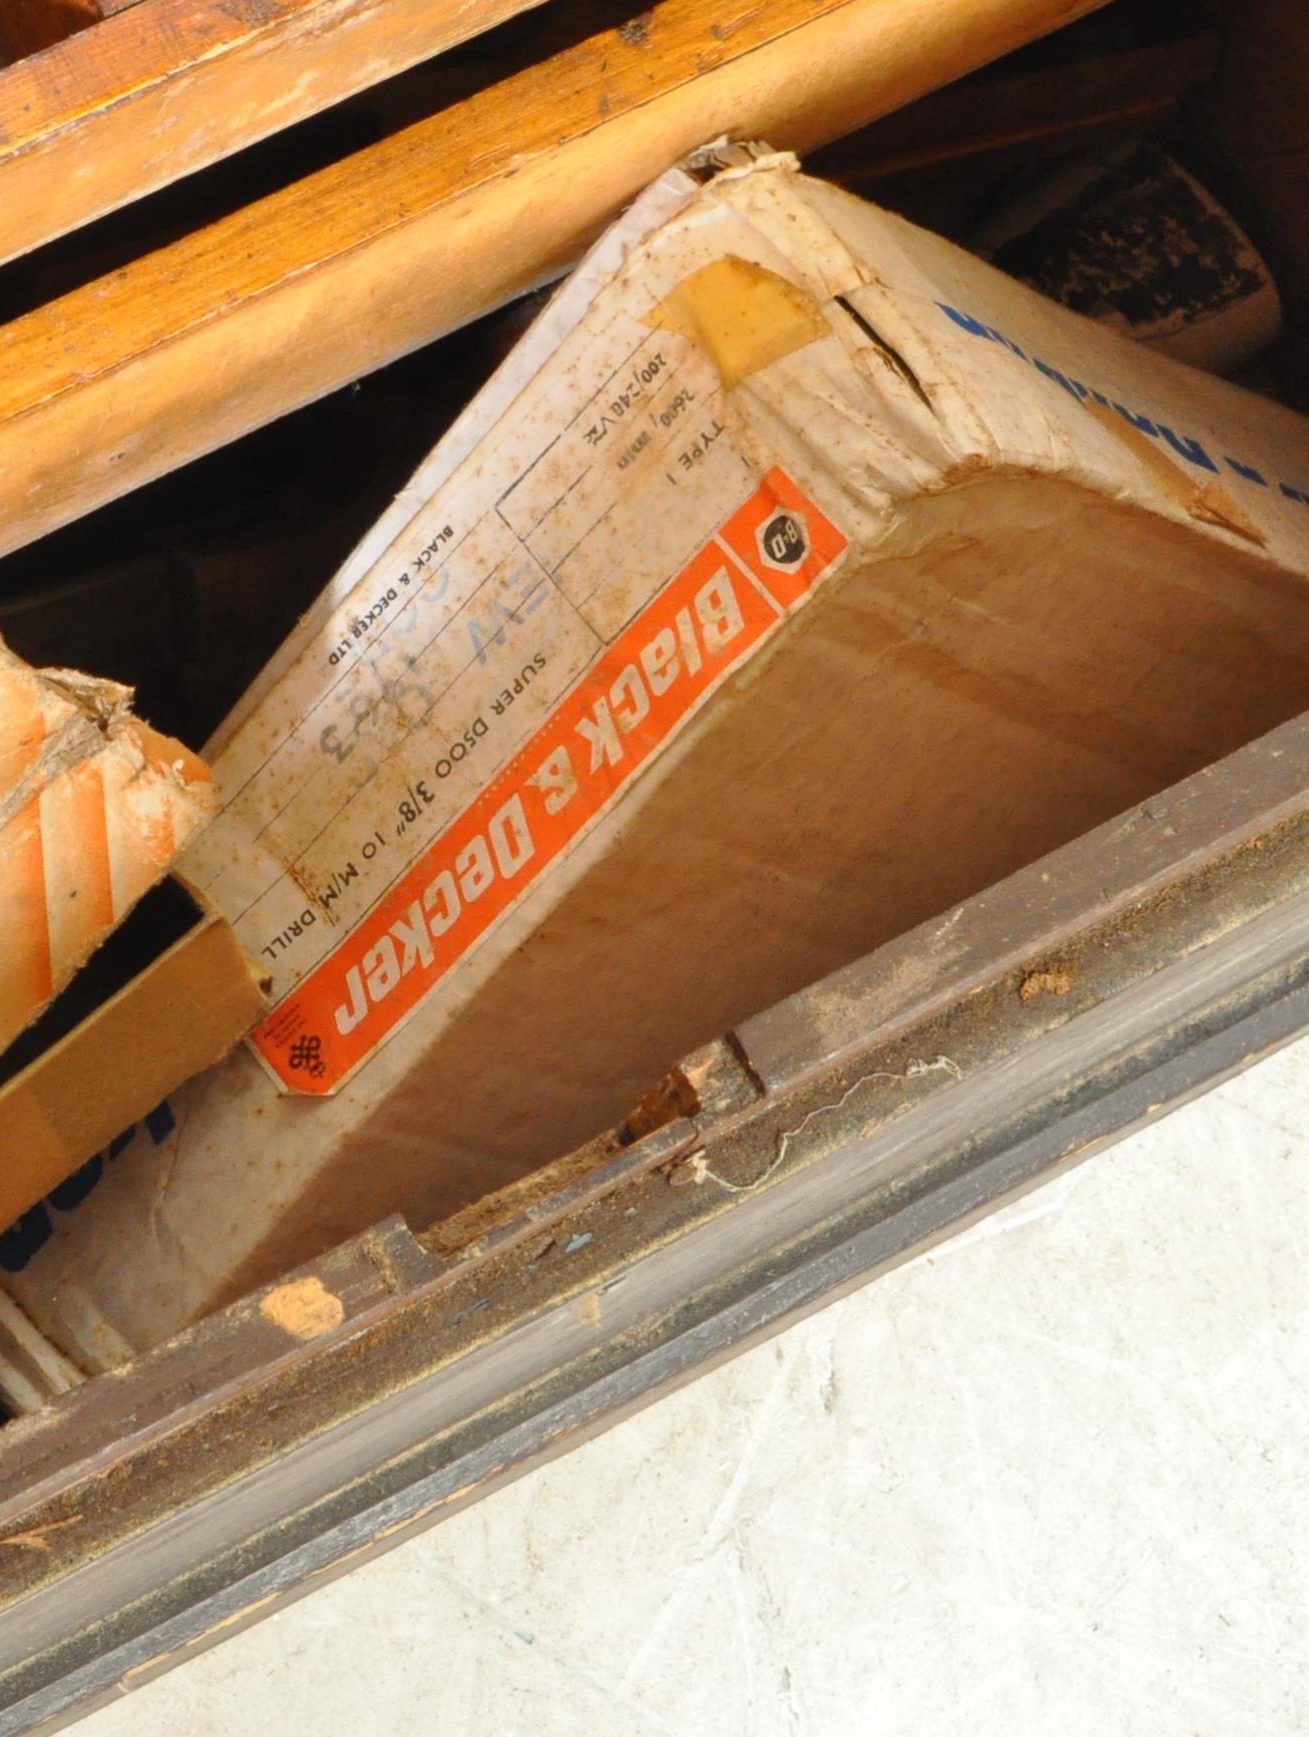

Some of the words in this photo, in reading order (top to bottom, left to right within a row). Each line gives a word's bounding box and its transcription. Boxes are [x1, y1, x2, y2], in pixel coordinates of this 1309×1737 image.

[677, 420, 726, 470] TYPE
[412, 524, 455, 571] BLACK
[398, 573, 412, 586] &
[351, 588, 399, 639] DECKER
[327, 640, 354, 666] LTD
[572, 565, 747, 774] Black
[490, 652, 548, 717] SUPER
[434, 717, 491, 779] D500
[531, 744, 579, 815] &
[317, 862, 360, 911] M/M
[260, 911, 318, 960] DRILL
[332, 822, 537, 1038] Decker
